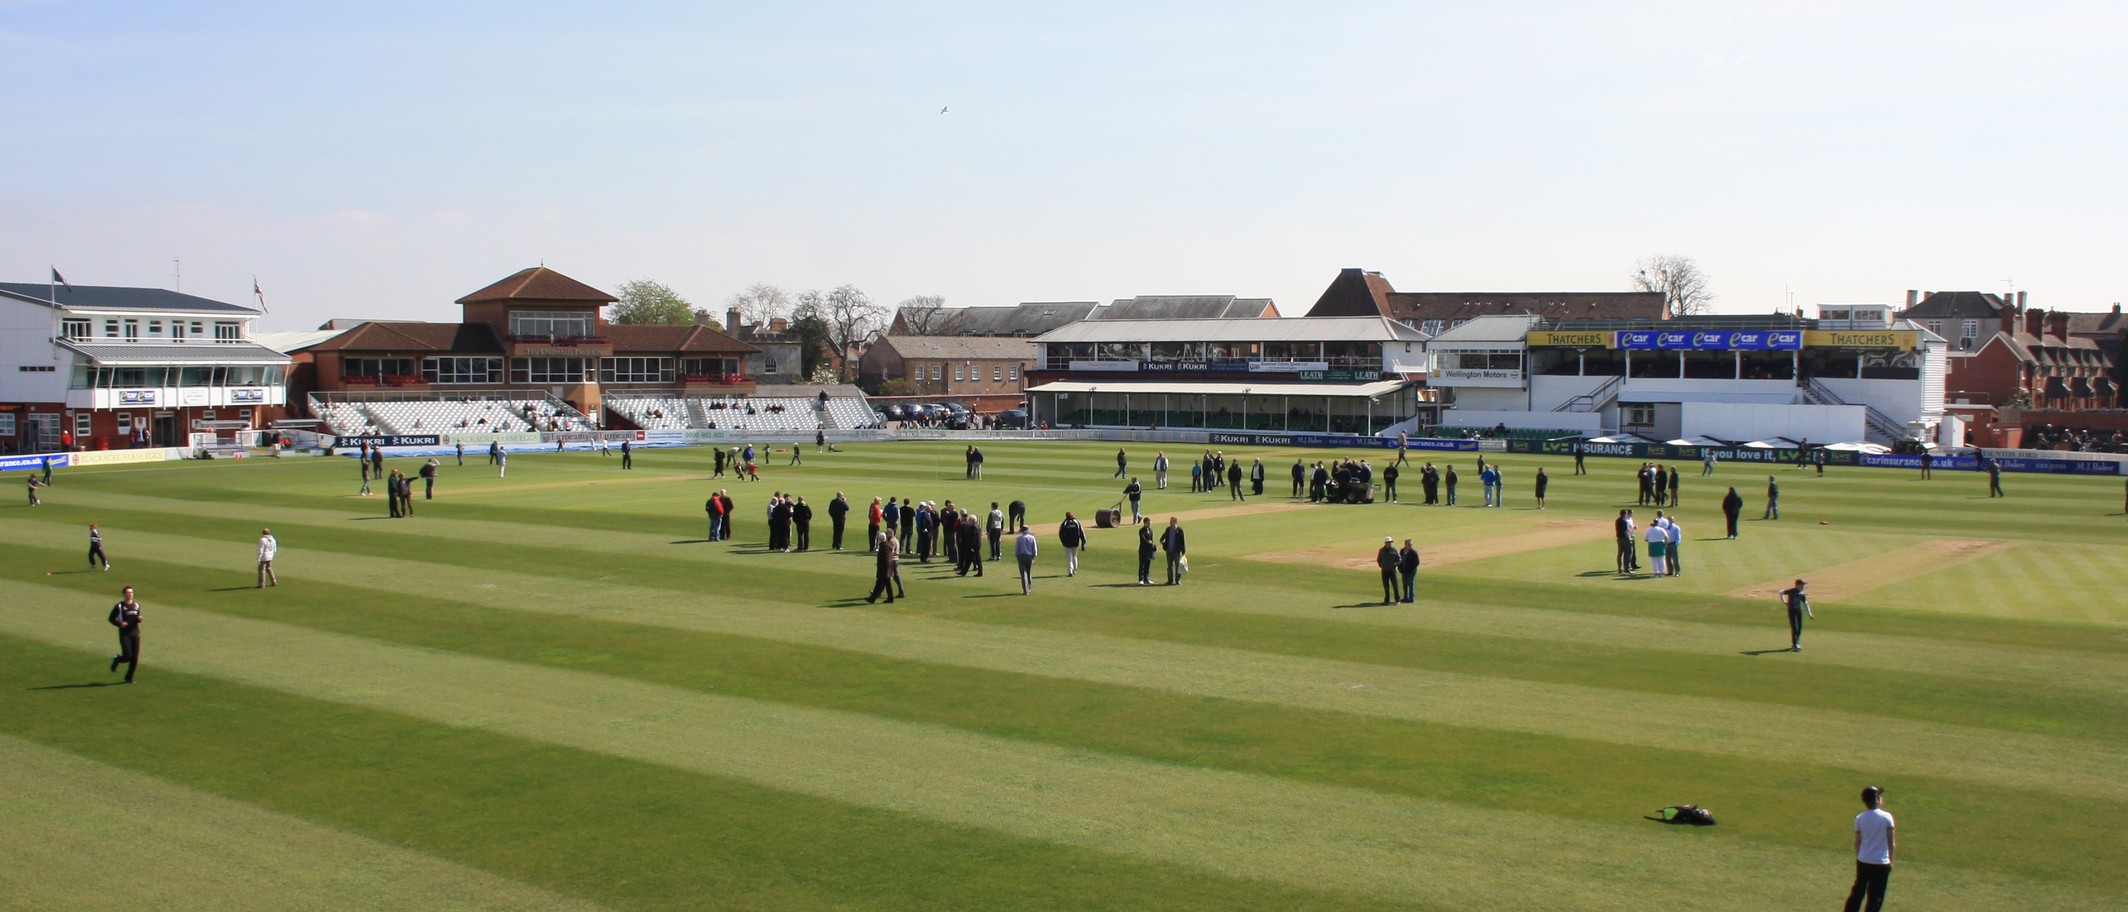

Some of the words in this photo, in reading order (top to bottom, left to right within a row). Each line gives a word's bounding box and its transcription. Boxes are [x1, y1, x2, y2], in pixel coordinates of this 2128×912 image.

[1547, 333, 1602, 345] THATCHERS
[1830, 333, 1895, 345] THATCHERS
[1300, 371, 1323, 379] LEATH
[1355, 371, 1379, 380] LEATH
[1445, 370, 1482, 379] Wellington
[1484, 370, 1507, 378] Motors
[401, 436, 435, 445] KUKRI
[1220, 435, 1249, 443] KUKRI
[1736, 449, 1761, 460] love
